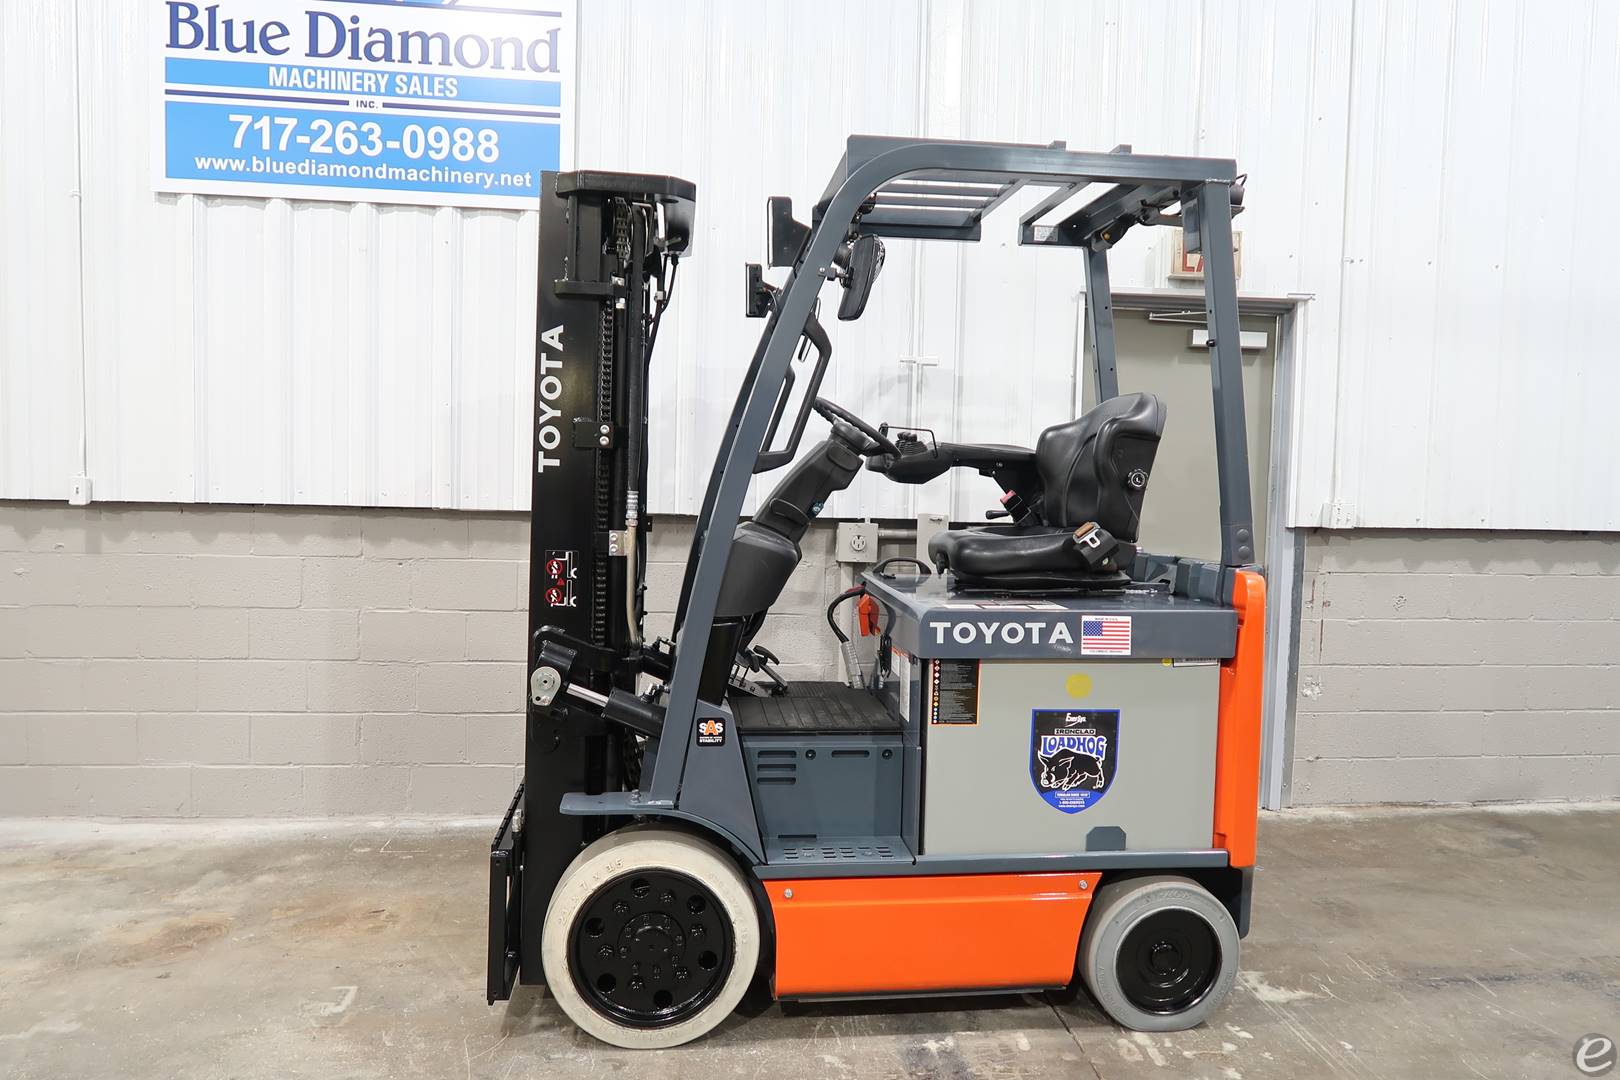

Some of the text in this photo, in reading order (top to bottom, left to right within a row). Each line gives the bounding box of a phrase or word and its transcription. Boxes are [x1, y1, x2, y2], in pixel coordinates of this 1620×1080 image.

[166, 1, 561, 73] Blue Diamond
[268, 66, 459, 98] MACHINERY SALES
[355, 99, 379, 109] INC.
[228, 114, 500, 163] 717-263-0988
[194, 156, 532, 189] www.bluediamondmachinery.net
[538, 324, 564, 473] TOYOTA
[929, 621, 1074, 645] TOYOTA
[698, 720, 724, 736] SAS
[1055, 728, 1096, 736] IRONCLAD
[1041, 735, 1107, 758] LOADHOG
